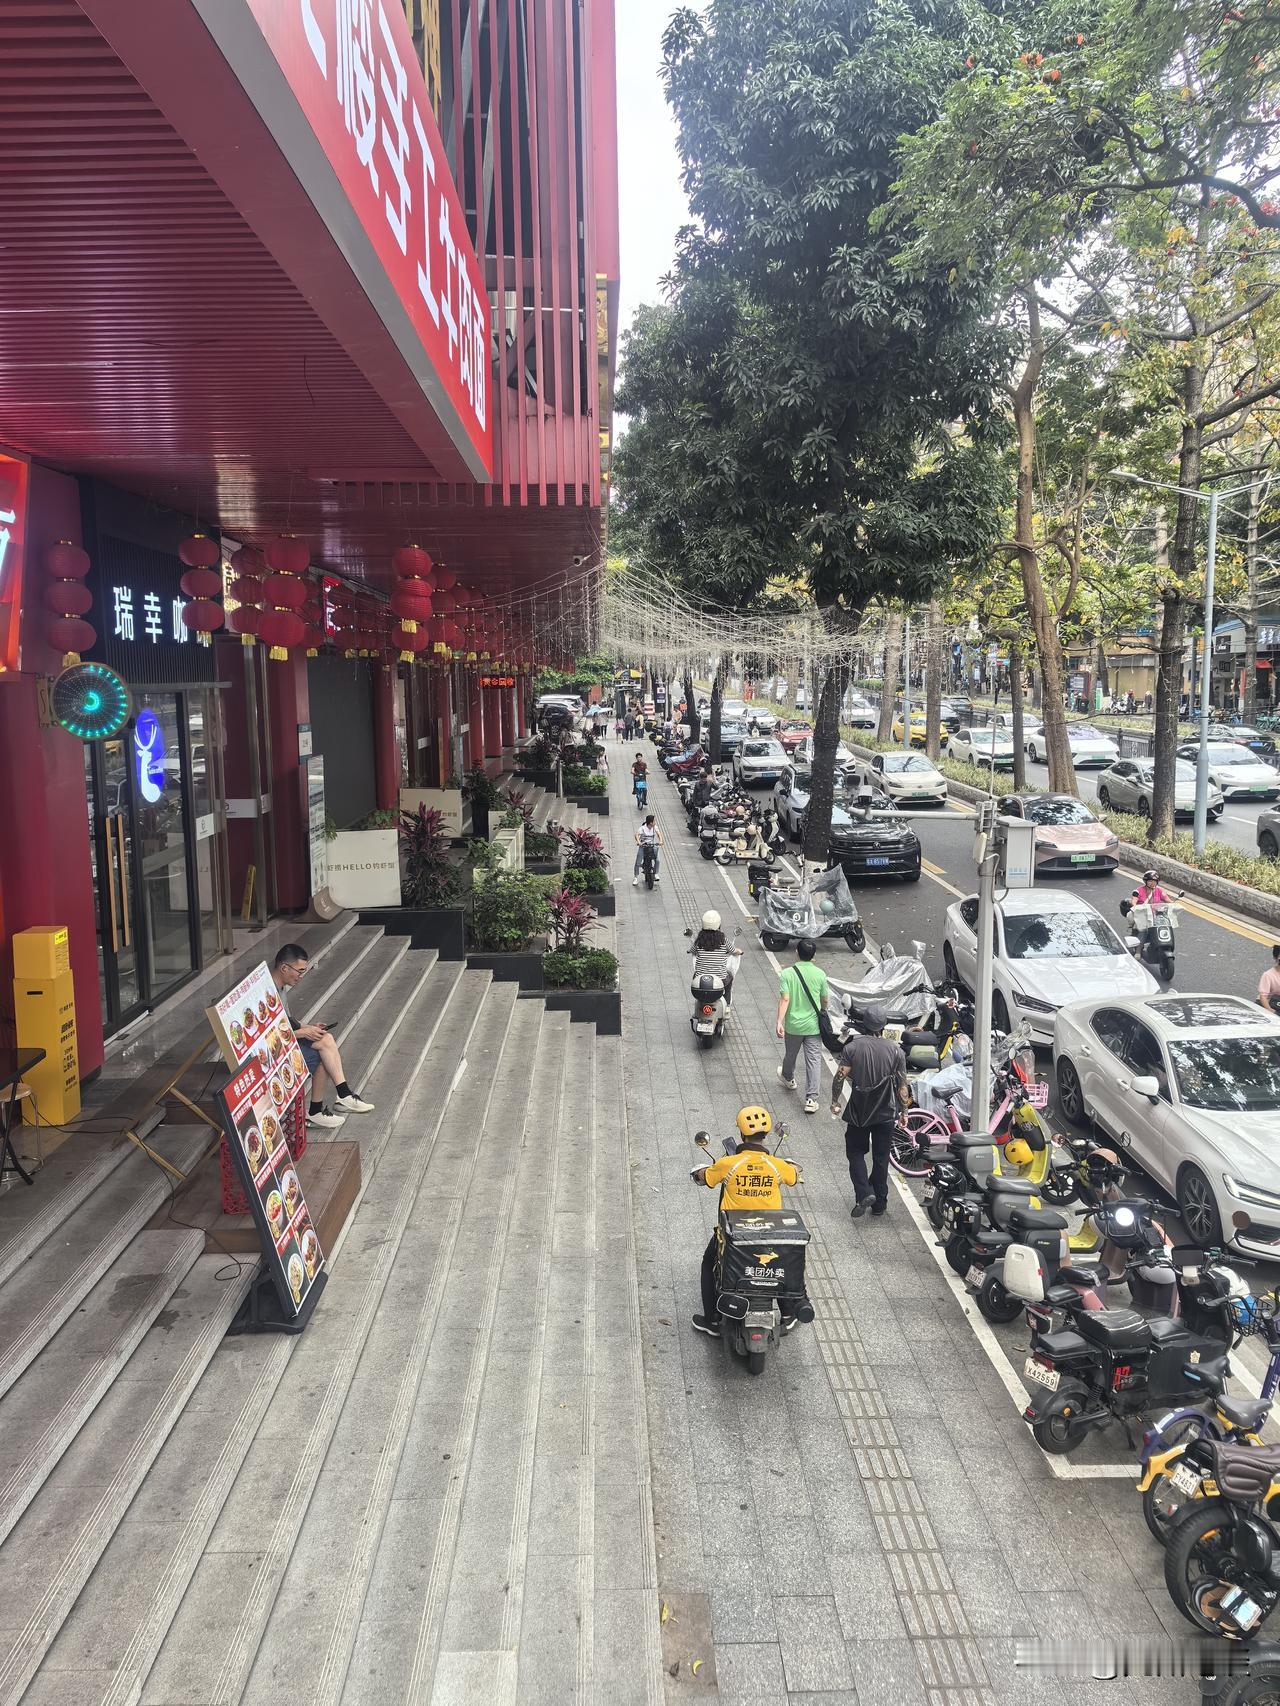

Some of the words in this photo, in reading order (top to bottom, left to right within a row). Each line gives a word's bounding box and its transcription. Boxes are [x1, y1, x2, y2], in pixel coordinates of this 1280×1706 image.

[113, 586, 212, 647] 瑞幸咖
[736, 1175, 774, 1187] 订酒店
[736, 1189, 772, 1197] 上美团App
[744, 1266, 785, 1278] 美团外卖
[1027, 1367, 1055, 1386] X42559
